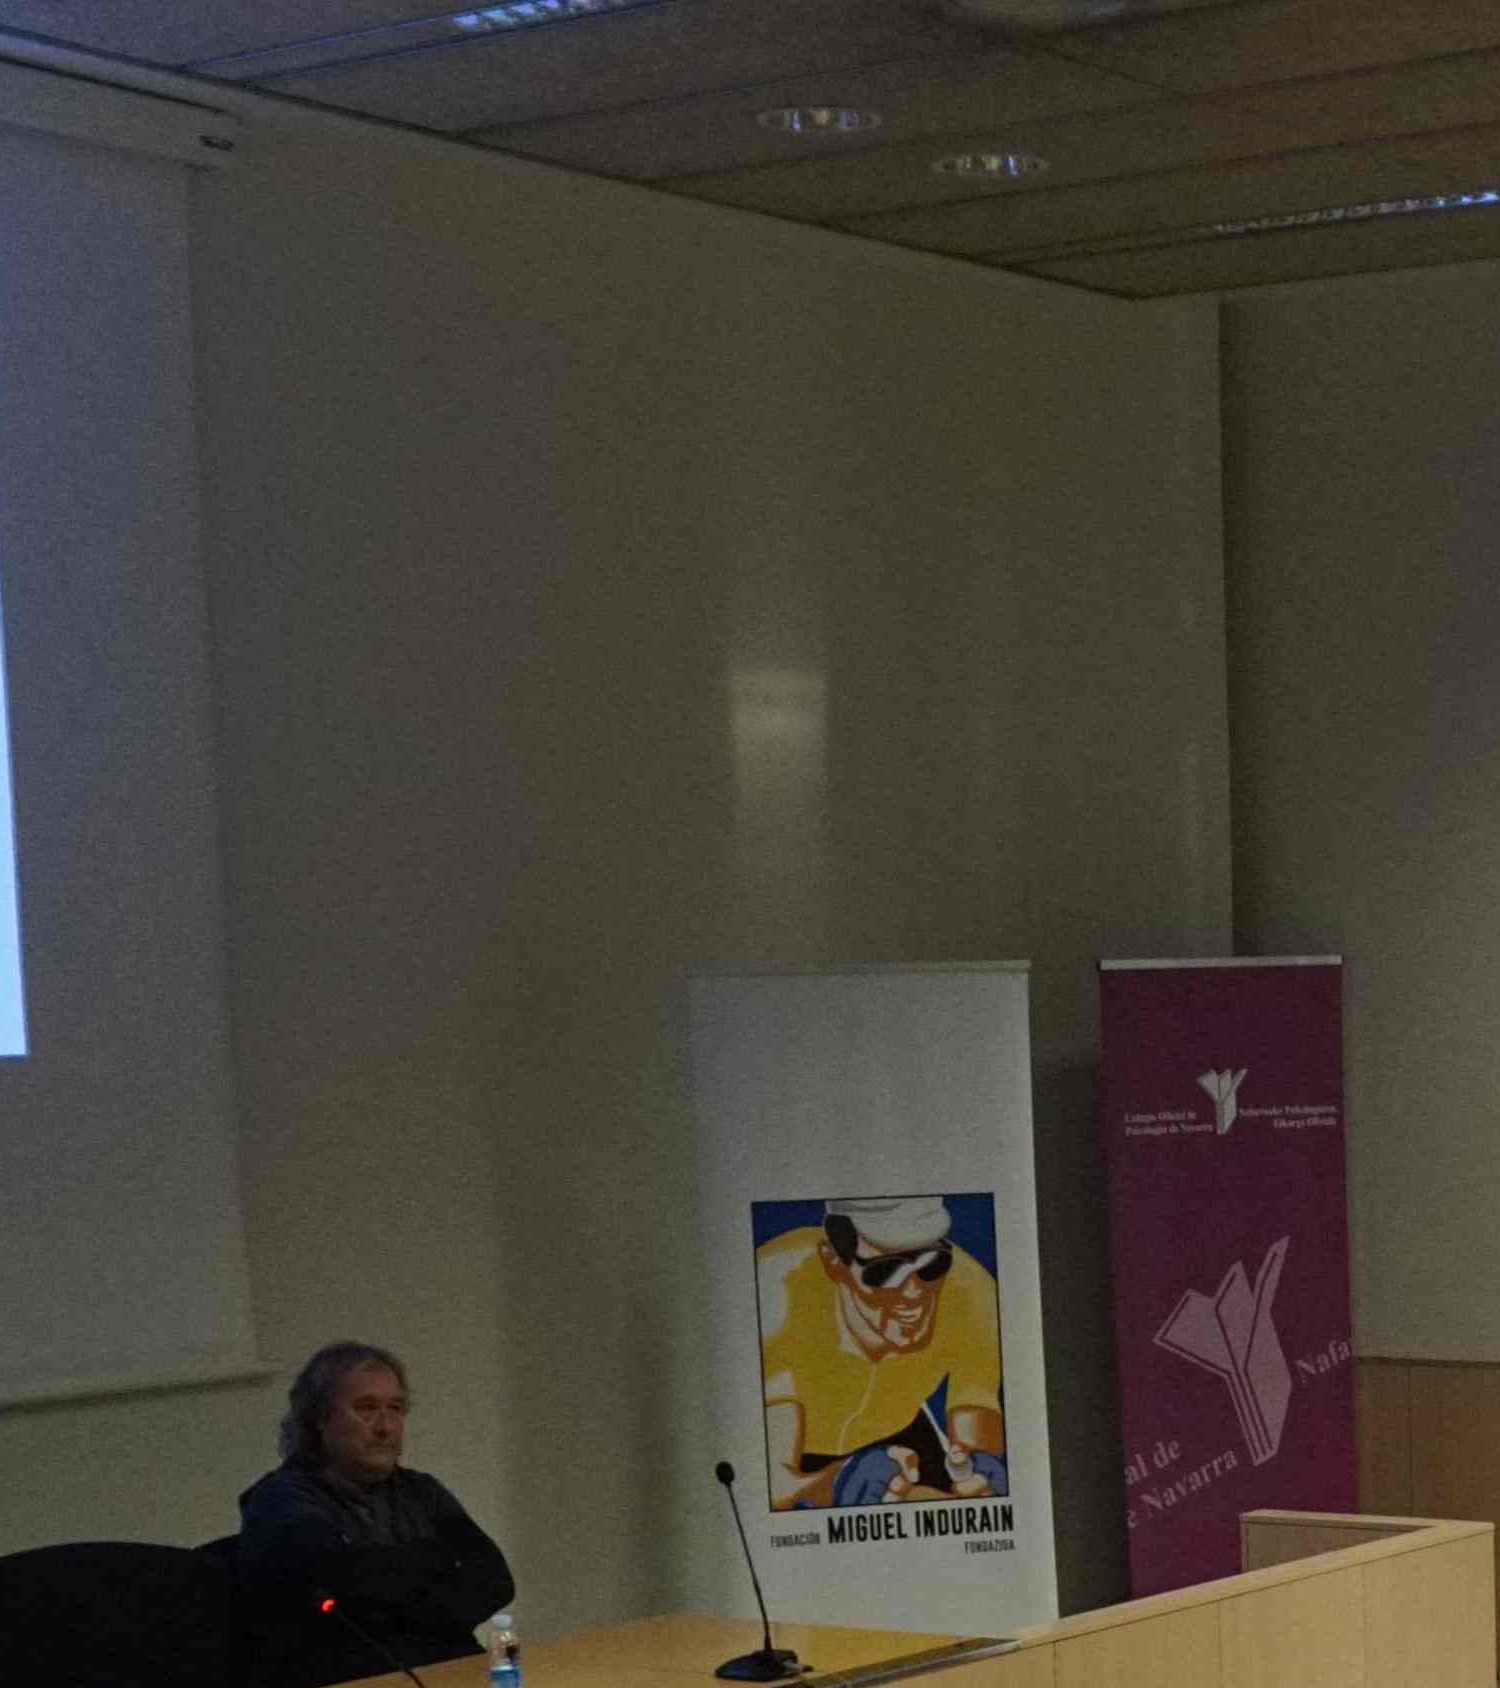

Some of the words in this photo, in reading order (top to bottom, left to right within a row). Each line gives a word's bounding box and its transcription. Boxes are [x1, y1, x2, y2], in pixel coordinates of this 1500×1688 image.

[1153, 1440, 1181, 1469] de
[1140, 1449, 1238, 1518] Navarra
[828, 1511, 908, 1545] MIGUEL
[915, 1505, 1015, 1538] INDURAIN
